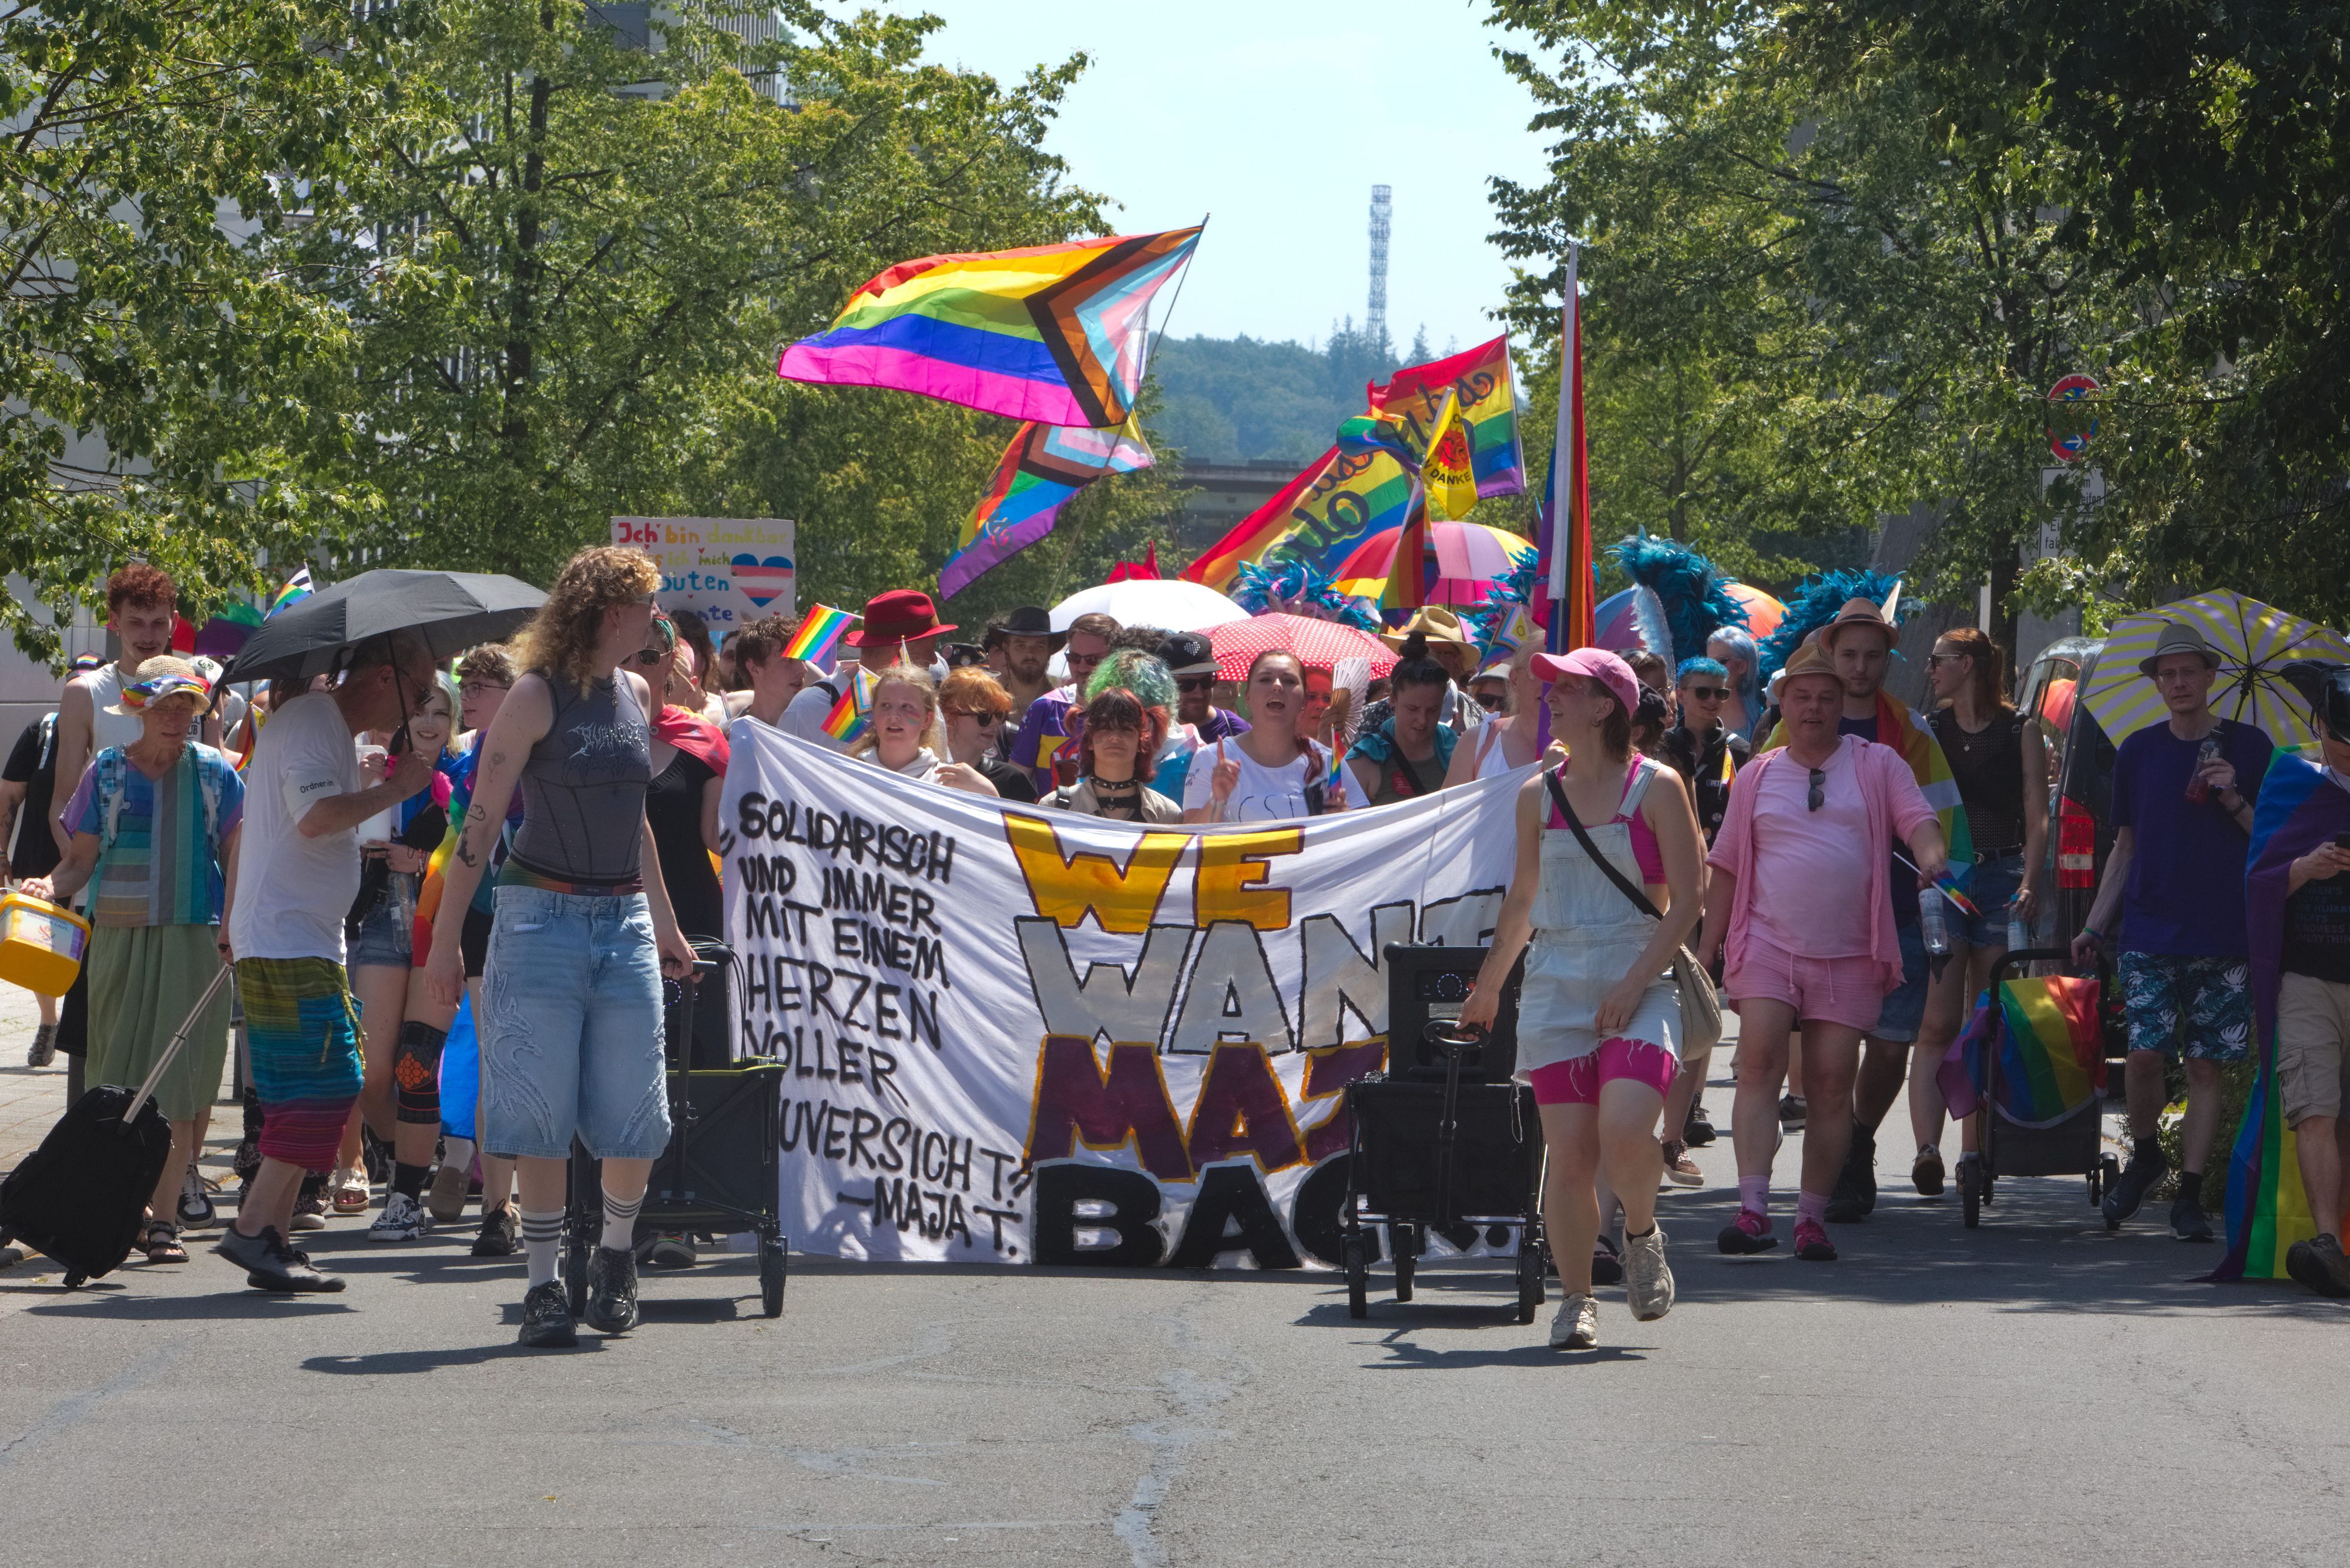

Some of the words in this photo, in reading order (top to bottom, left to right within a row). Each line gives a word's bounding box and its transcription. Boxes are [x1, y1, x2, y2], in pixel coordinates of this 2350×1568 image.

[1430, 468, 1471, 485] DANKE
[666, 525, 700, 544] bin
[707, 523, 788, 544] dankbar
[667, 550, 690, 566] ich
[699, 551, 730, 566] mich
[300, 780, 334, 793] Ordner:in
[738, 853, 797, 895] UND
[821, 867, 941, 934] IMMER
[1000, 811, 1305, 934] WE
[746, 894, 824, 946] MIT
[833, 918, 950, 989] EINEM
[2296, 934, 2350, 944] EVERYTHIN
[748, 953, 941, 1050] HERZEN
[744, 1019, 908, 1106] VOLLER
[973, 1205, 1023, 1256] T.
